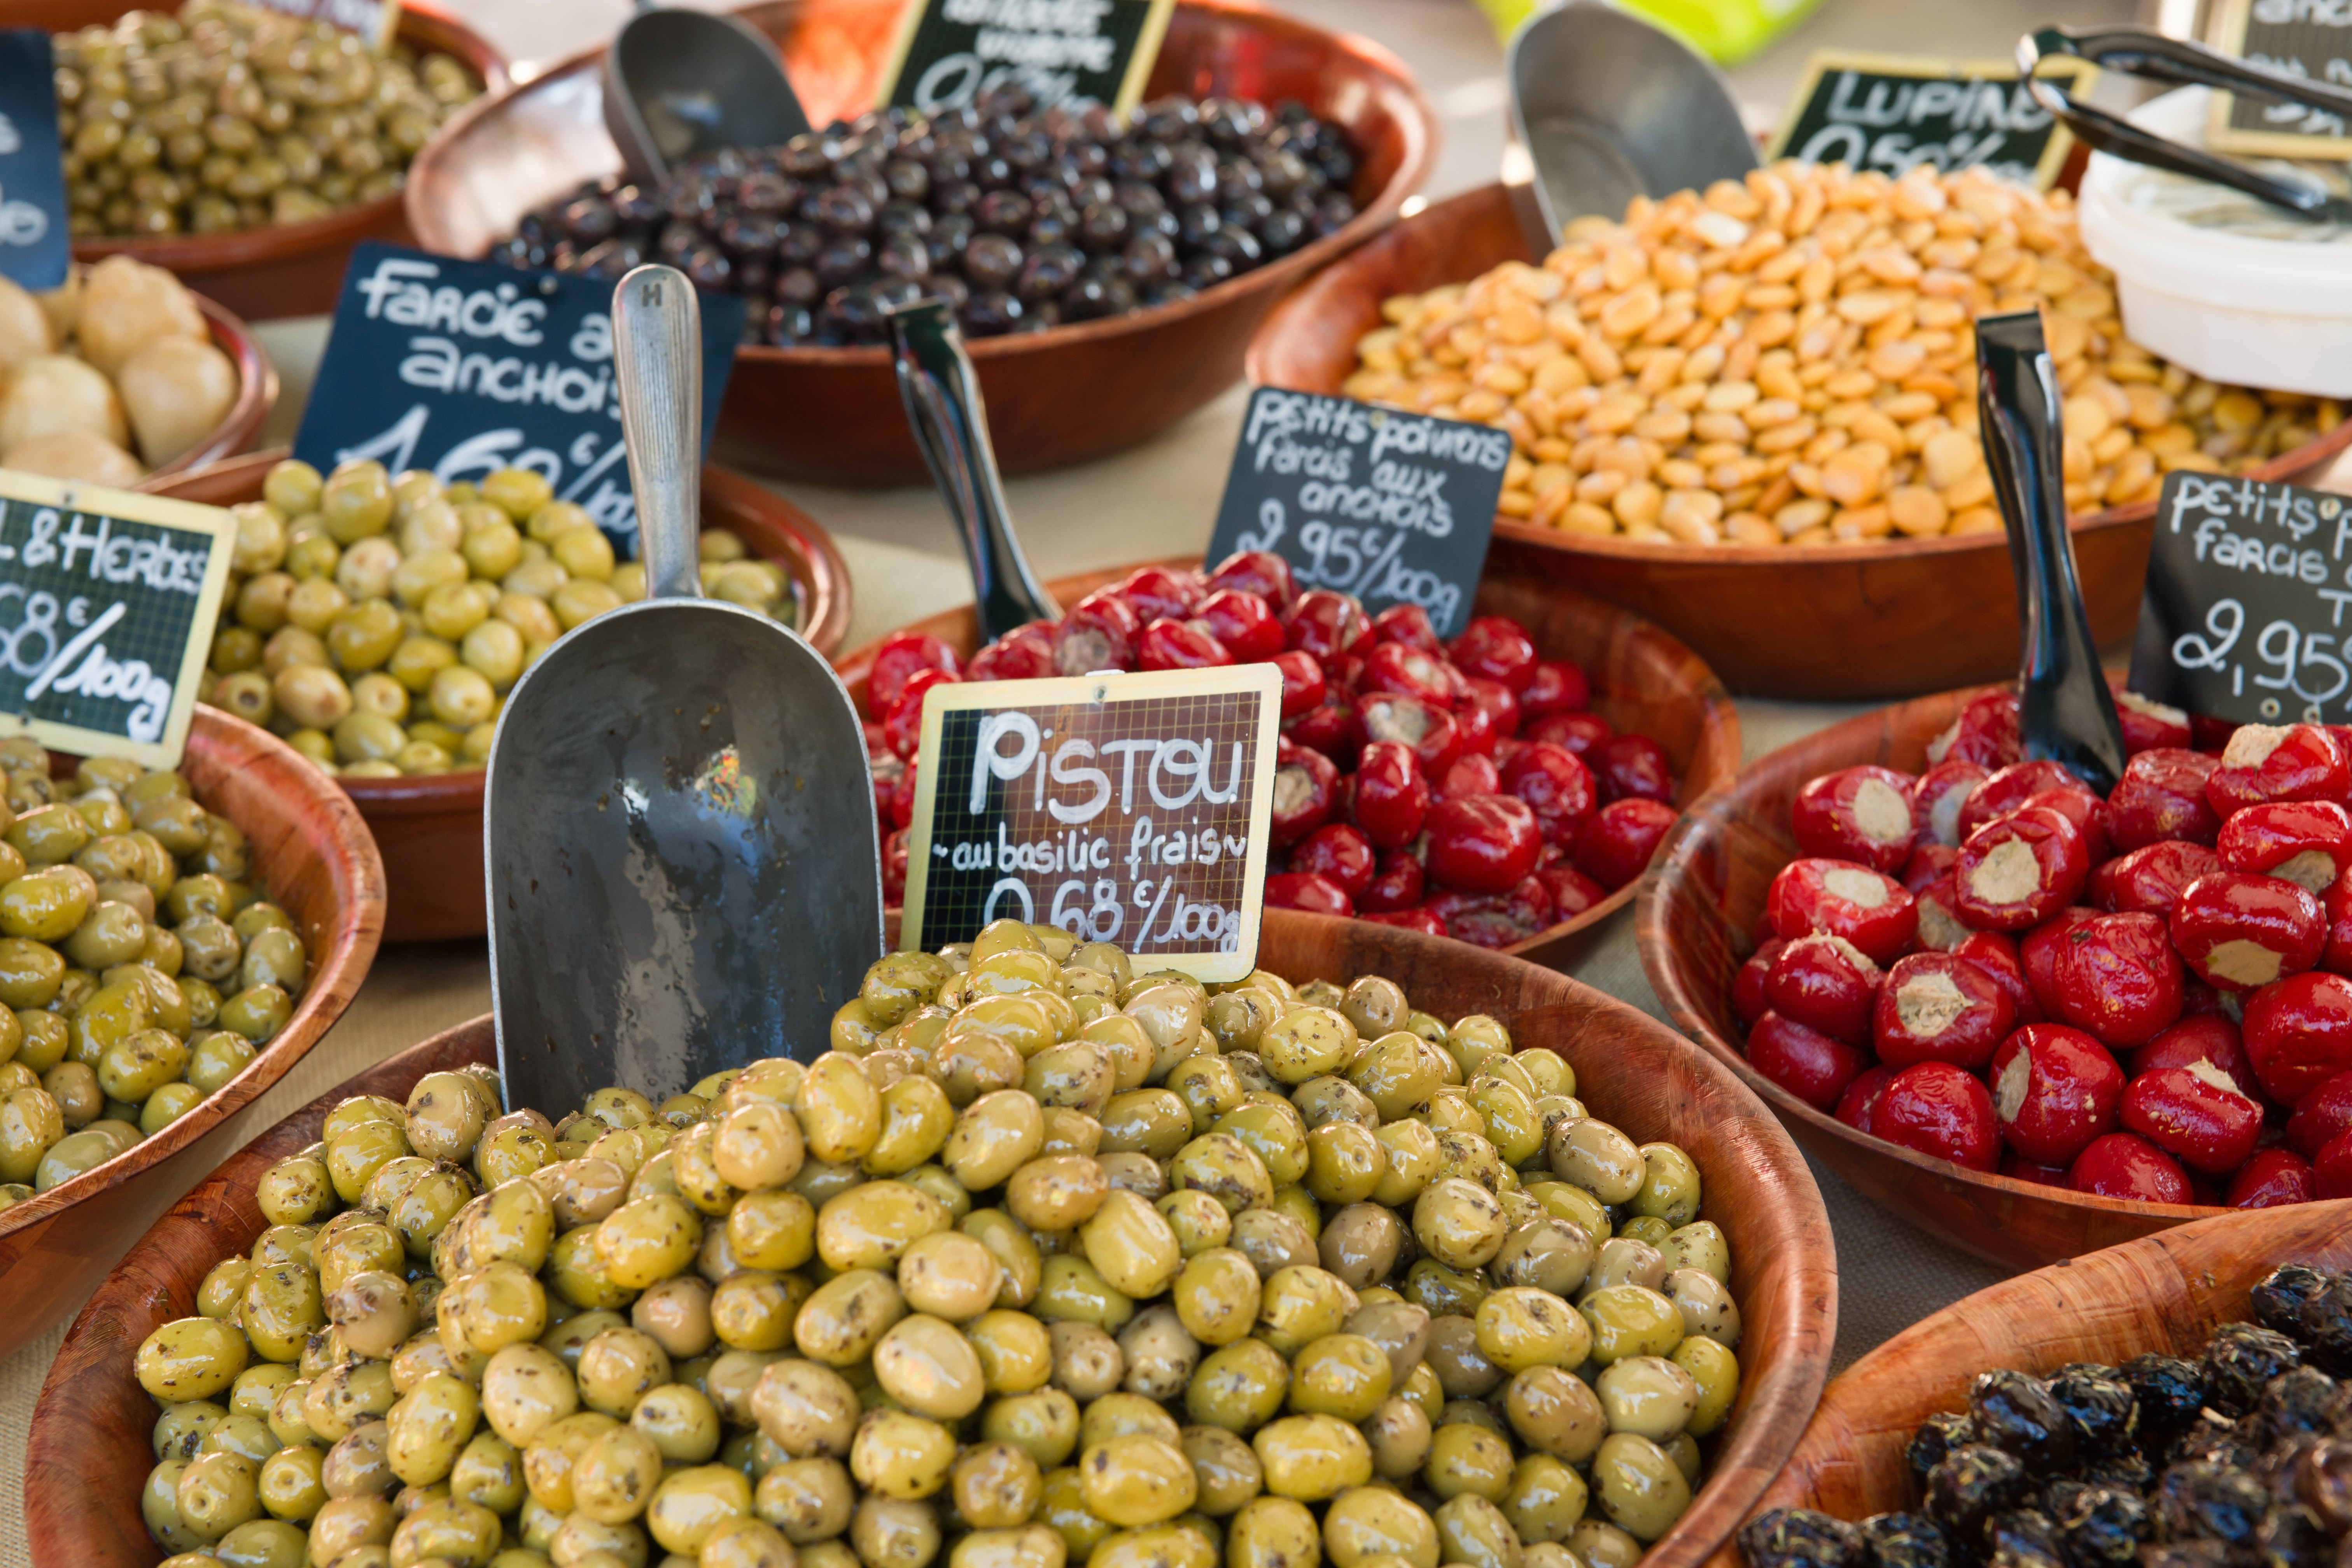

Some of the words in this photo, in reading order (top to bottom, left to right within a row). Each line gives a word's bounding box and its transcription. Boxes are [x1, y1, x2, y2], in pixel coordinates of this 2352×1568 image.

[642, 283, 662, 306] H
[1371, 460, 1448, 505] aux
[22, 507, 60, 567] &
[997, 820, 1110, 874] basilic
